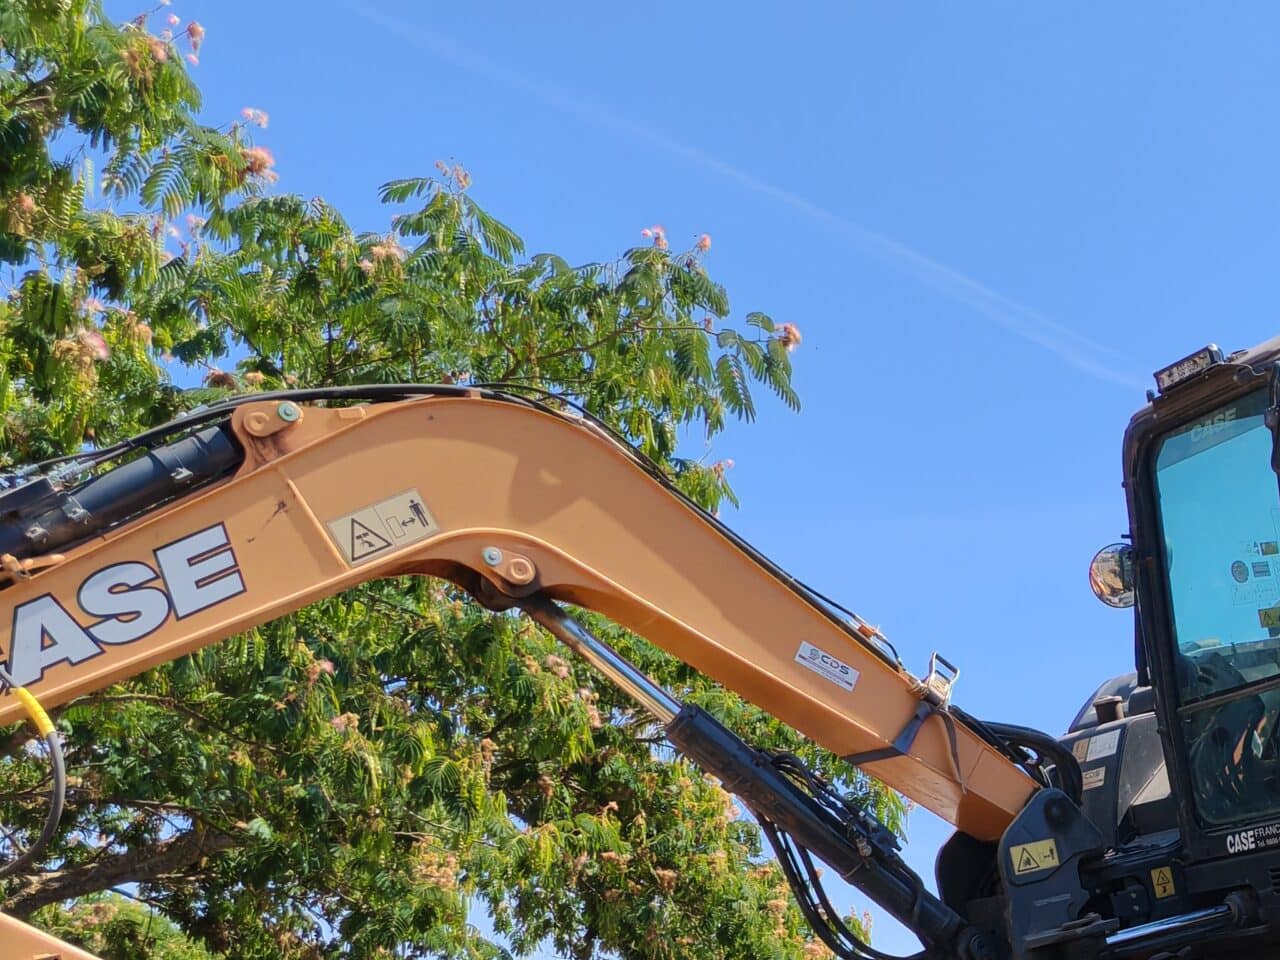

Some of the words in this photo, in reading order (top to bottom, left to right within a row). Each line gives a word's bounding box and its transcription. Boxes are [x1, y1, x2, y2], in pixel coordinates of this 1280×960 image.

[1191, 407, 1236, 441] CASE
[0, 521, 247, 695] ASE
[821, 655, 849, 675] CDS
[1226, 831, 1255, 854] CASE
